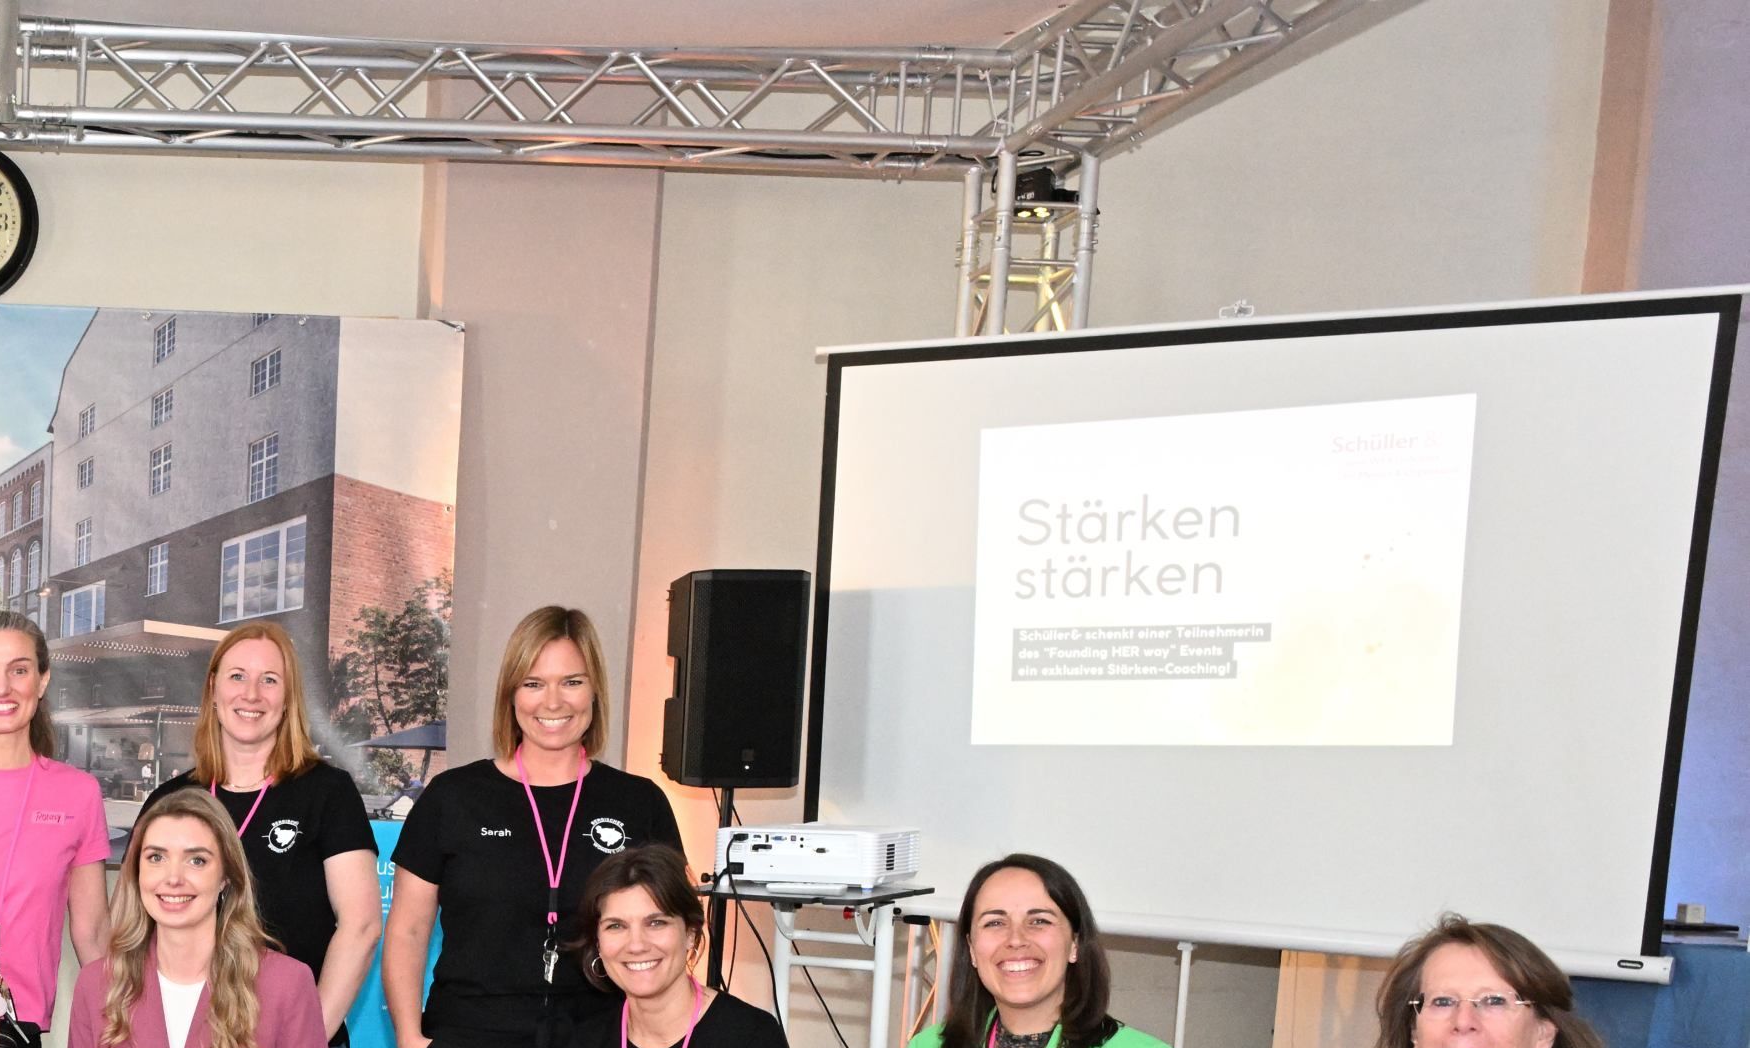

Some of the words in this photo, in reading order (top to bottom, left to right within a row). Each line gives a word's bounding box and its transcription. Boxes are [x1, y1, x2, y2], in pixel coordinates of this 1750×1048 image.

[0, 213, 9, 231] 3
[1331, 432, 1418, 453] Schüller
[1017, 493, 1240, 546] Stärken
[1015, 549, 1223, 600] stärken
[1085, 627, 1134, 641] schenkt
[1138, 628, 1172, 640] einer
[1176, 625, 1264, 639] Teilnehmerin
[1018, 647, 1040, 660] des
[1111, 645, 1140, 658] HER
[1179, 644, 1223, 657] Events
[1018, 665, 1038, 676] ein
[1041, 663, 1104, 677] exklusives
[1107, 662, 1231, 677] Stärken-Coaching!
[480, 827, 512, 837] Sarah
